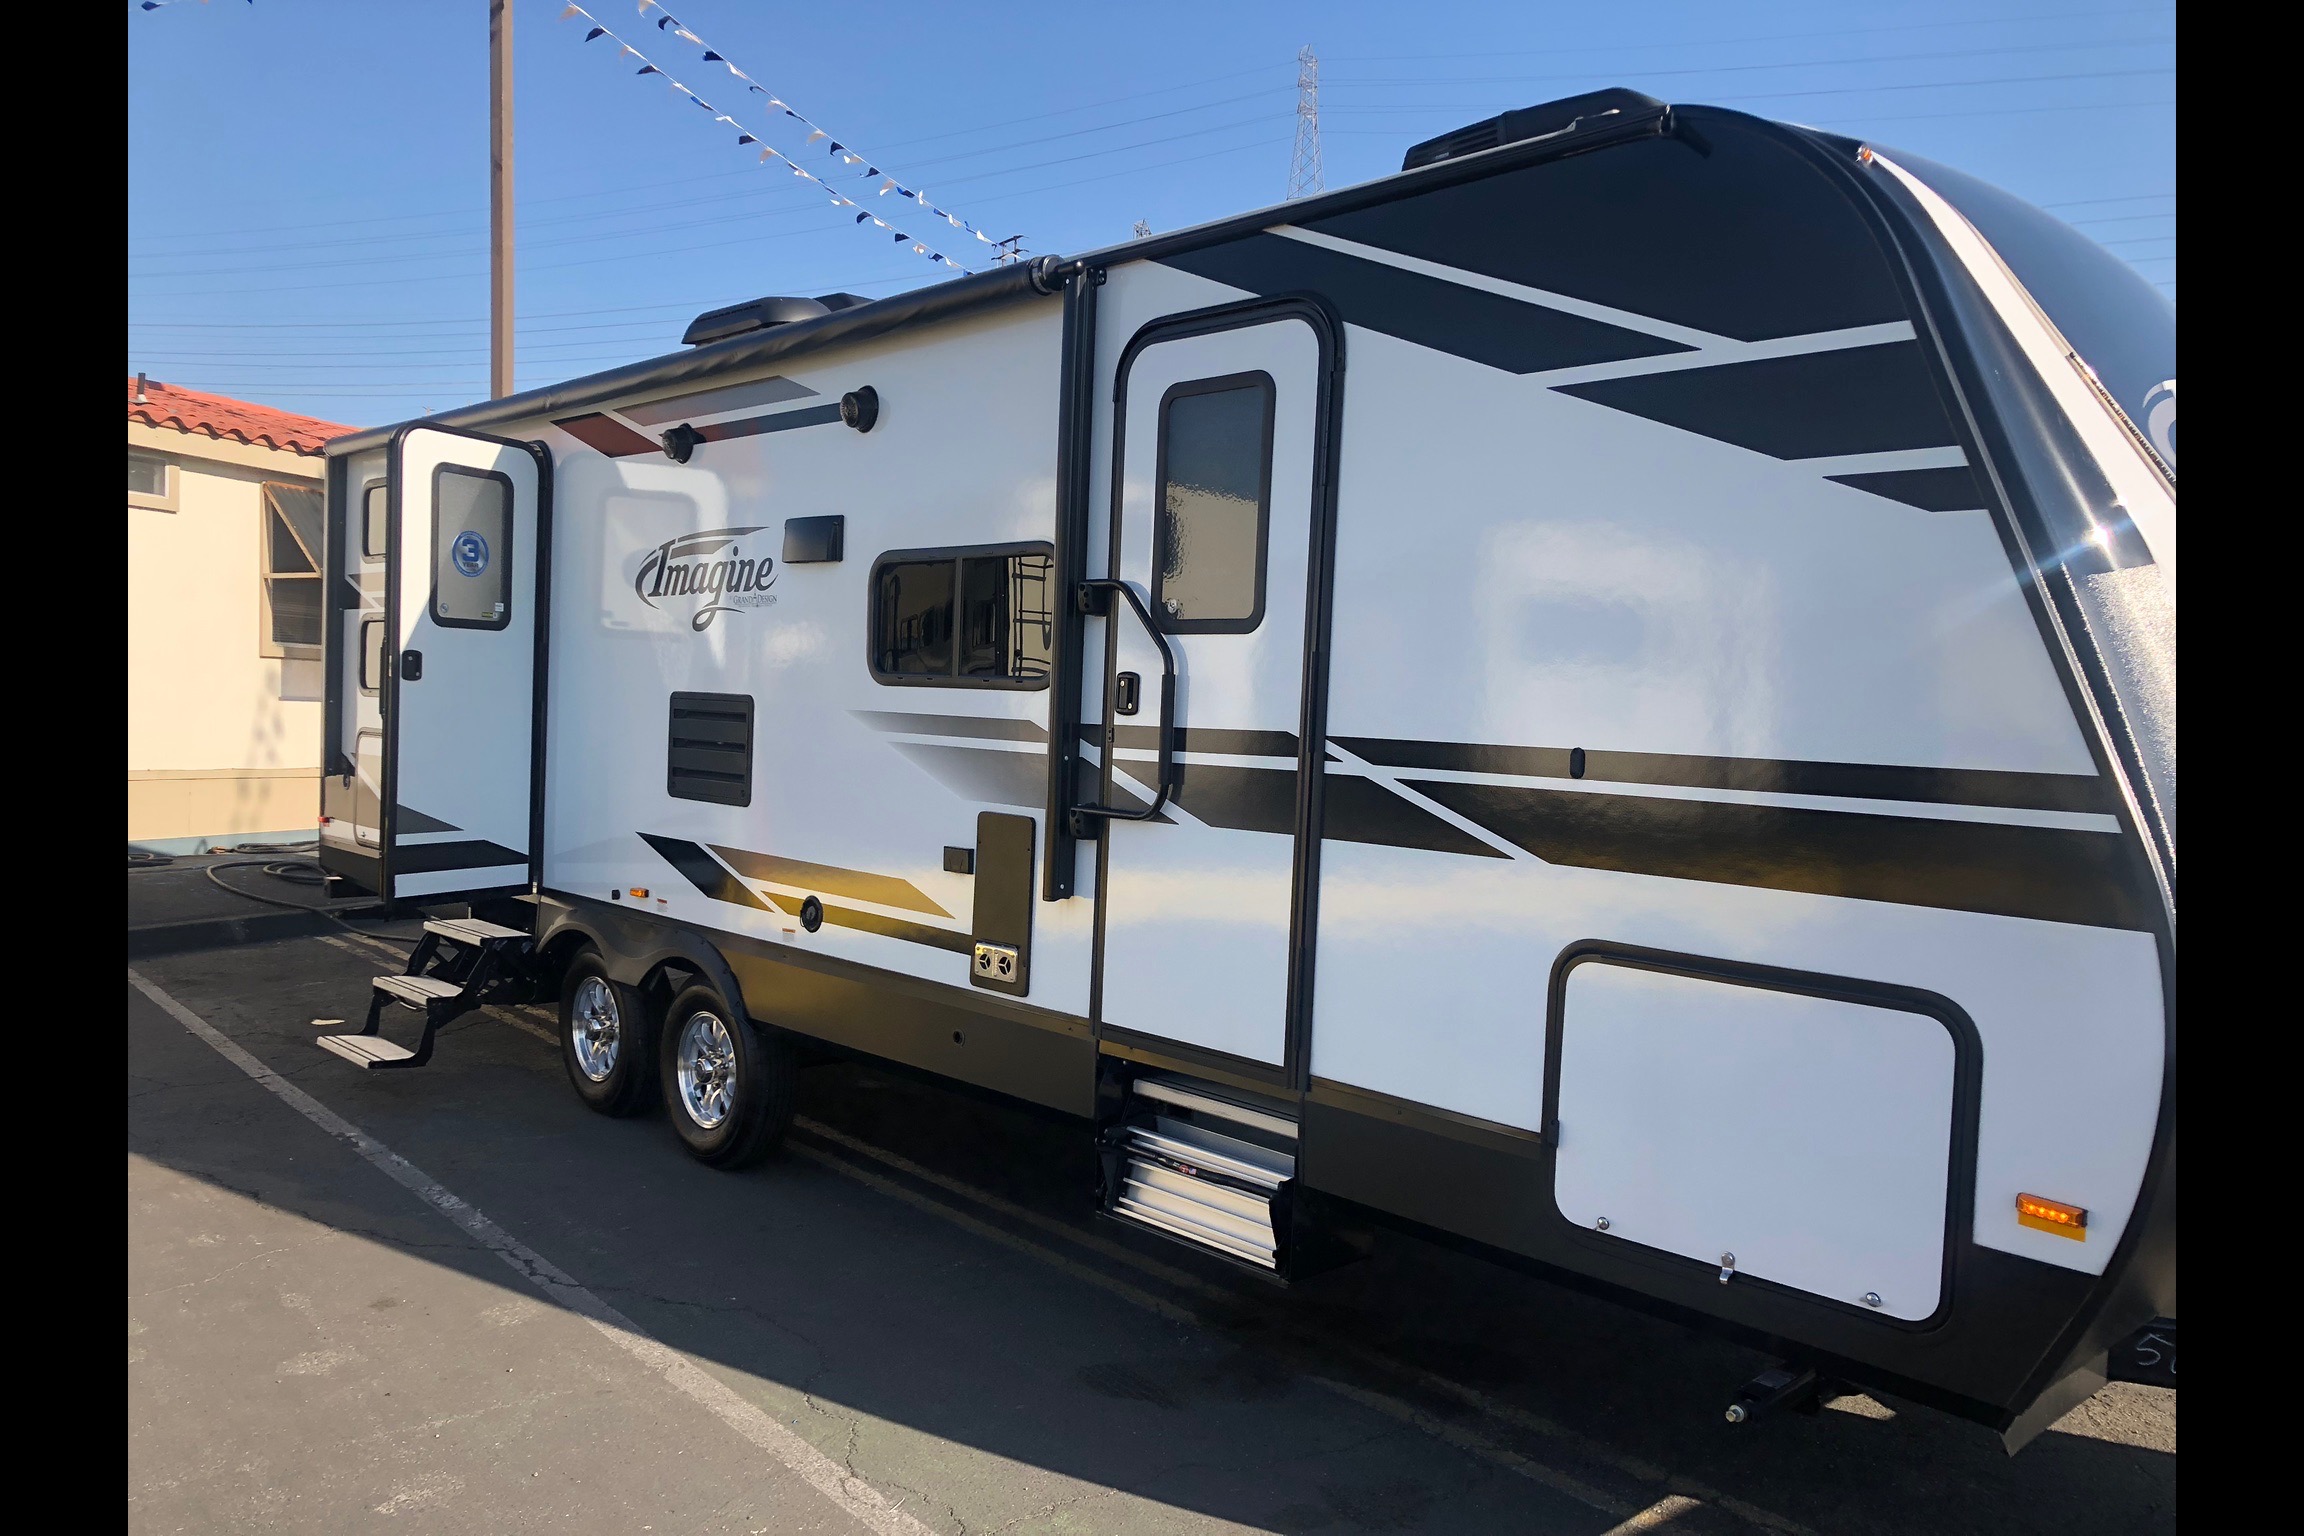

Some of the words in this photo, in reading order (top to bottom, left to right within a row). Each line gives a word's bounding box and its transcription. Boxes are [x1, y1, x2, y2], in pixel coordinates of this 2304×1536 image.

[462, 539, 480, 562] 3
[646, 537, 779, 632] Imagine
[733, 595, 753, 605] GRAND
[757, 594, 778, 604] DESIGN
[2136, 1332, 2176, 1375] 5
